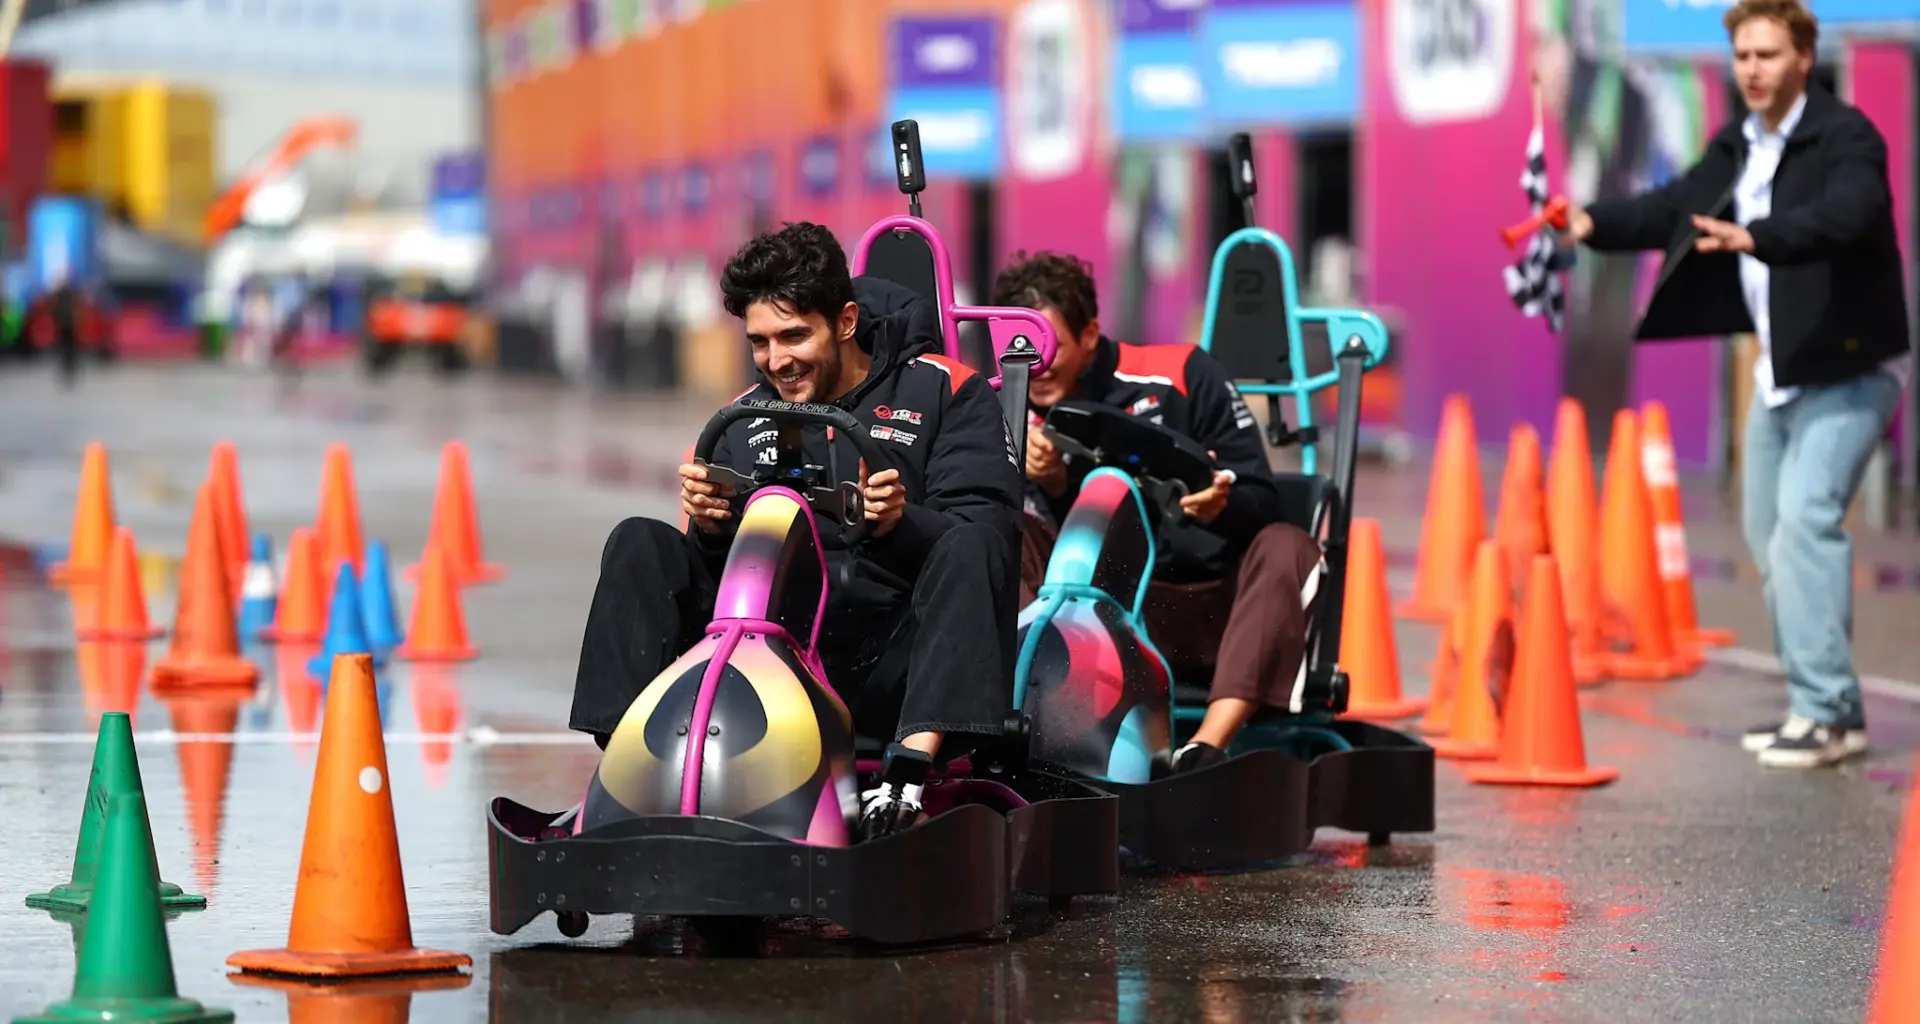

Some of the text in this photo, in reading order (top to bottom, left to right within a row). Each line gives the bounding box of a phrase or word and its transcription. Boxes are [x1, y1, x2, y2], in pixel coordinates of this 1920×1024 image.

[749, 400, 830, 414] THE GRID RACING
